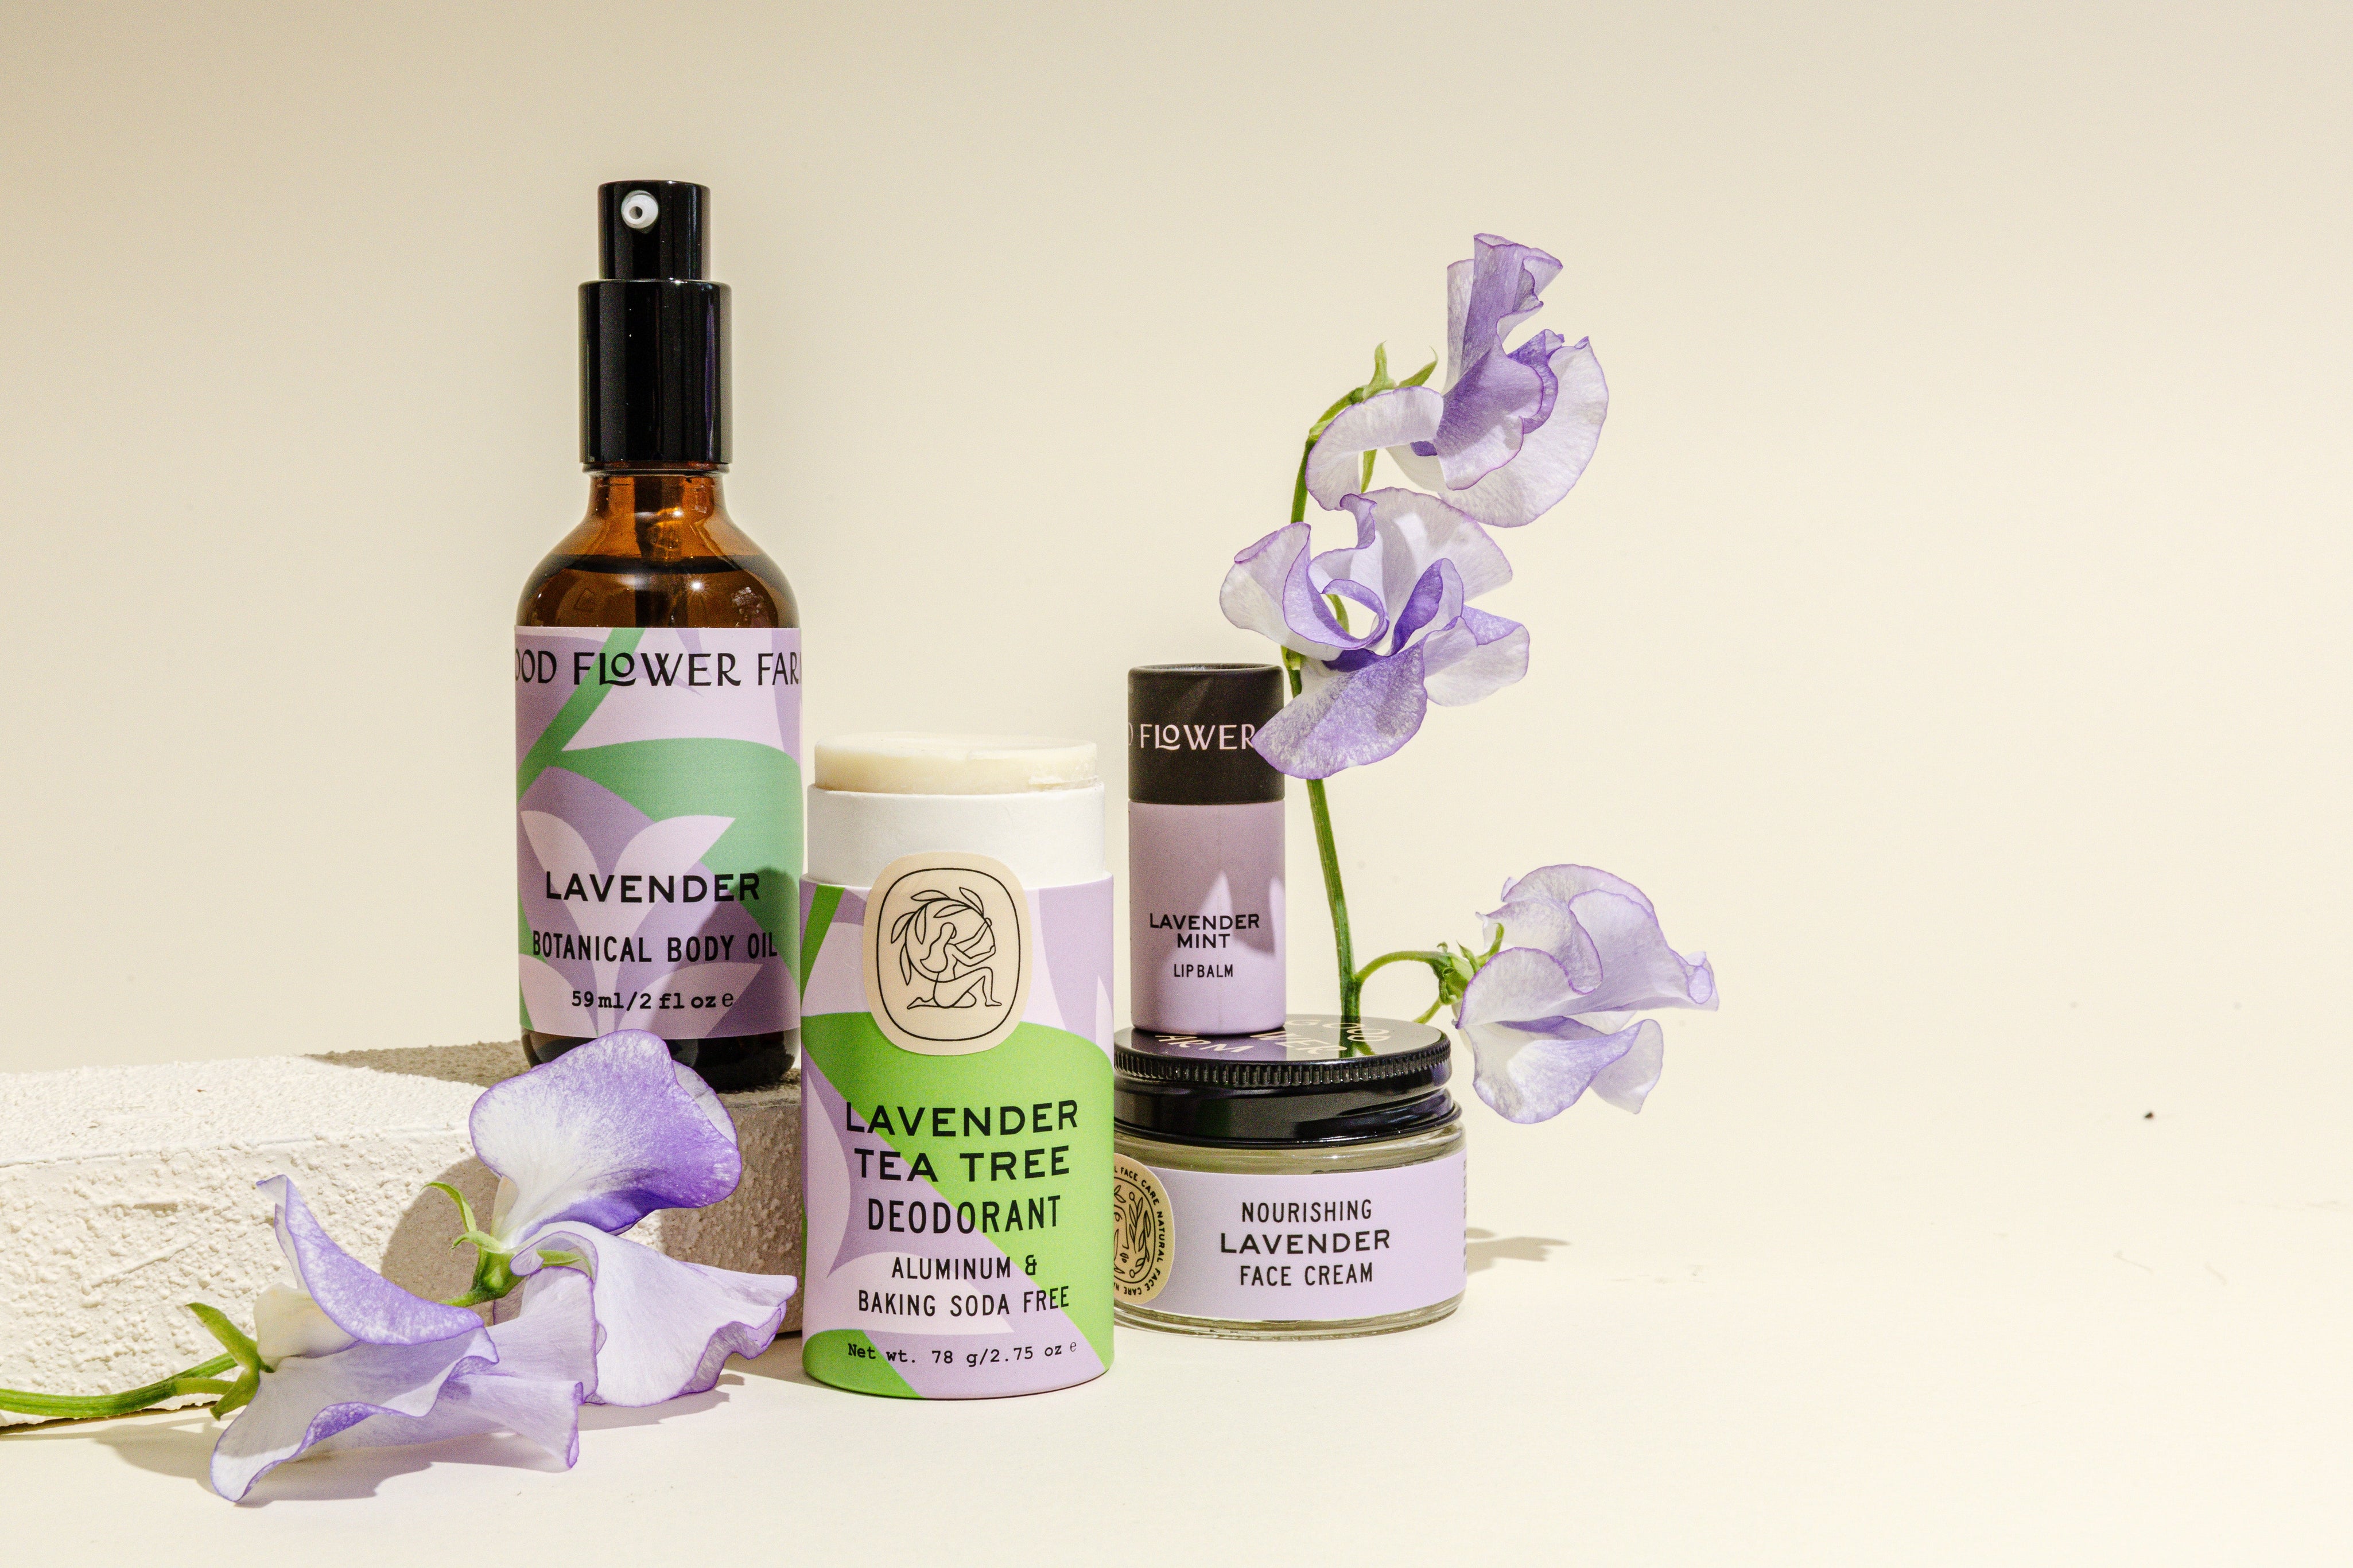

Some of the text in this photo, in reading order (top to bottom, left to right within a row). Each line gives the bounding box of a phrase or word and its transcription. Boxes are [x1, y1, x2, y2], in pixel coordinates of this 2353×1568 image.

[573, 652, 741, 687] FLOWER
[758, 651, 802, 686] FAR
[1140, 723, 1255, 751] FLOWER
[546, 871, 760, 904] LAVENDER
[1150, 913, 1260, 931] LAVENDER
[532, 930, 777, 962] BOTANICAL BODY OIL
[1177, 933, 1231, 949] MINT
[658, 993, 685, 1009] fl
[690, 996, 716, 1009] oz
[1154, 1035, 1255, 1053] ARM
[846, 1100, 1077, 1137] LAVENDER
[854, 1145, 1069, 1182] TEA TREE
[868, 1195, 1061, 1234] DEODORANT
[1242, 1199, 1372, 1224] NOURISHING
[1120, 1167, 1166, 1295] FACE CARE NATURAL FACE CARE
[1220, 1229, 1390, 1255] LAVENDER
[891, 1254, 1038, 1280] ALUMINUM &
[1240, 1262, 1373, 1286] FACE CREAM
[858, 1285, 1070, 1317] BAKING SODA FREE
[847, 1342, 876, 1360] Net
[885, 1349, 916, 1364] wt.
[931, 1349, 954, 1364] 78
[966, 1346, 1034, 1368] g/2.75
[1044, 1344, 1062, 1357] oz
